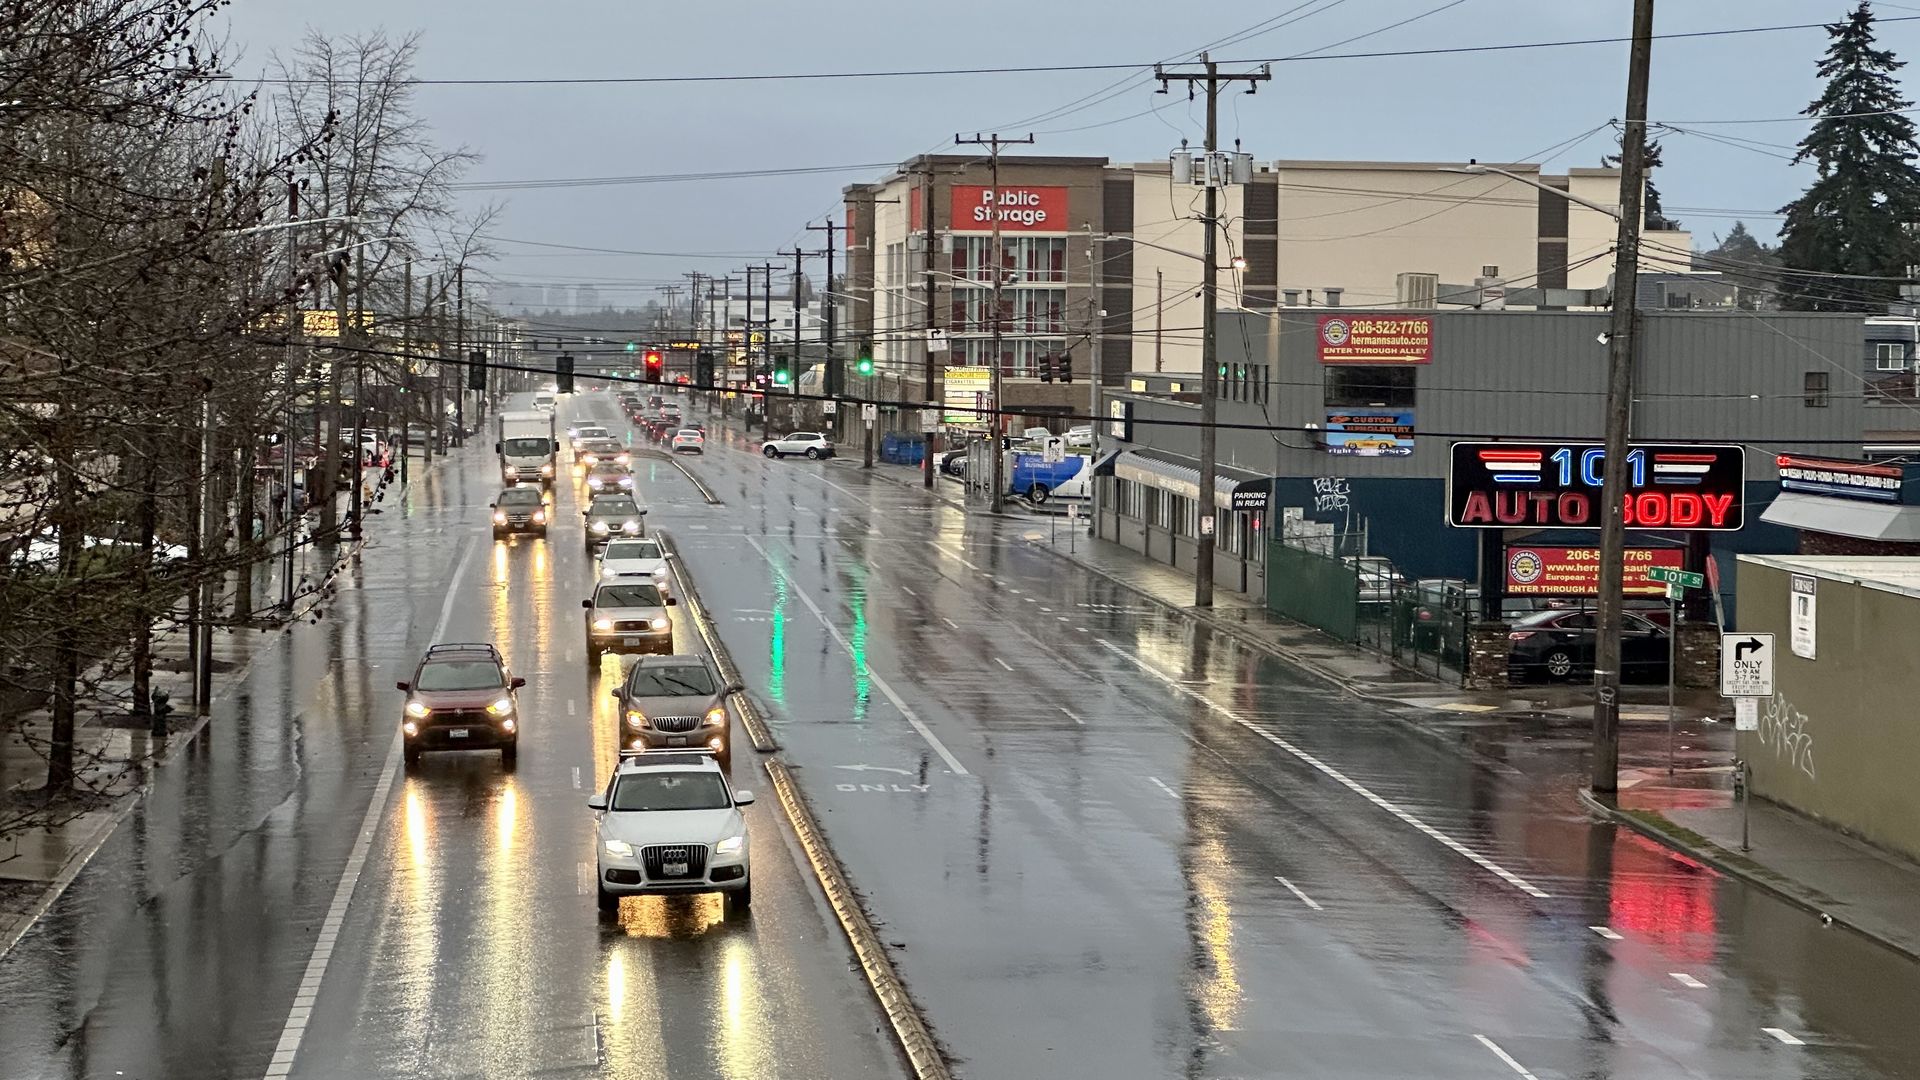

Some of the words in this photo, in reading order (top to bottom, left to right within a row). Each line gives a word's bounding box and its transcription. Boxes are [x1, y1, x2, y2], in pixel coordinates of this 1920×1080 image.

[982, 190, 1040, 206] Public
[974, 206, 1047, 226] Storage
[1351, 320, 1428, 334] 206-522-7766
[1351, 335, 1428, 345] hermannsauto.com
[1461, 491, 1590, 524] AUTO
[1546, 573, 1586, 582] European
[1691, 576, 1701, 585] St
[1734, 660, 1763, 669] ONLY
[835, 784, 932, 792] ONLY
